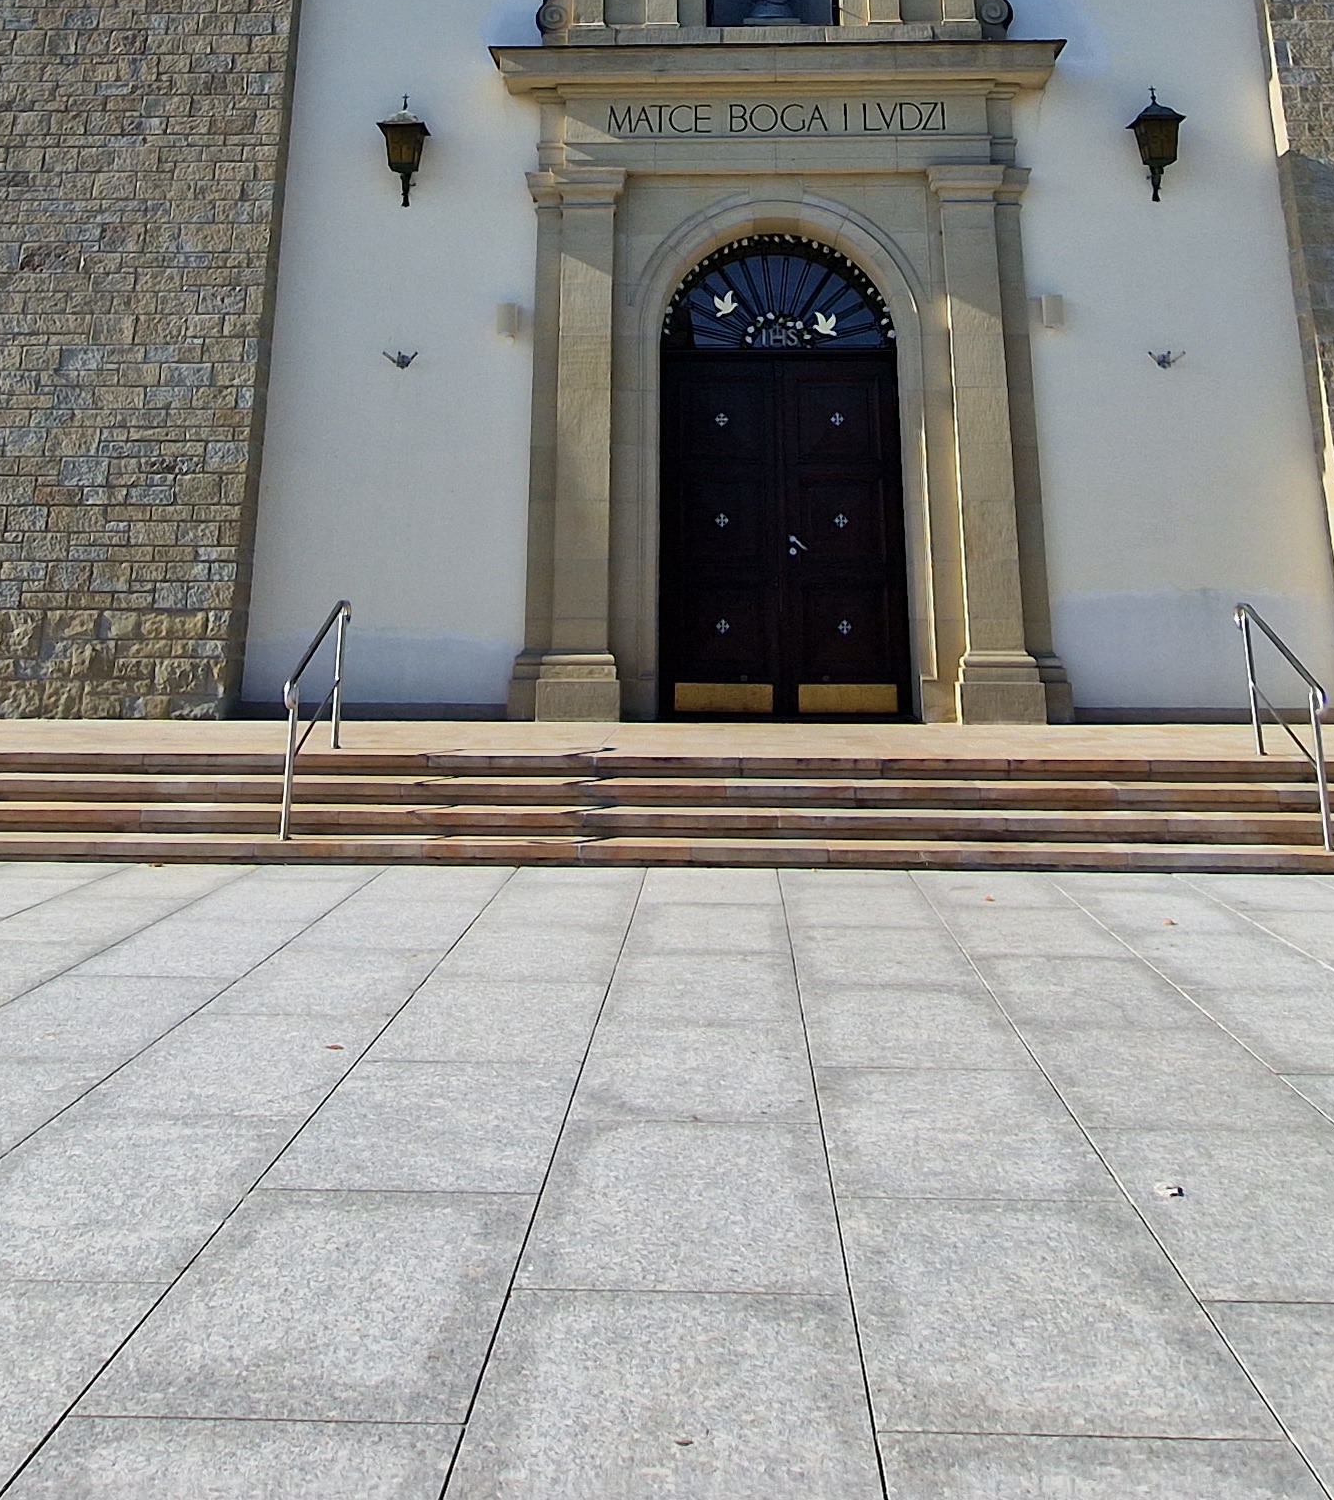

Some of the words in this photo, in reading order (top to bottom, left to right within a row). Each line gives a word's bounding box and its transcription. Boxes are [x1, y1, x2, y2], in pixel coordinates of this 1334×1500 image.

[607, 104, 712, 133] MATCE
[728, 103, 828, 133] BOGA
[842, 102, 849, 132] I
[862, 101, 947, 132] LVDZI
[761, 327, 799, 347] IHS
